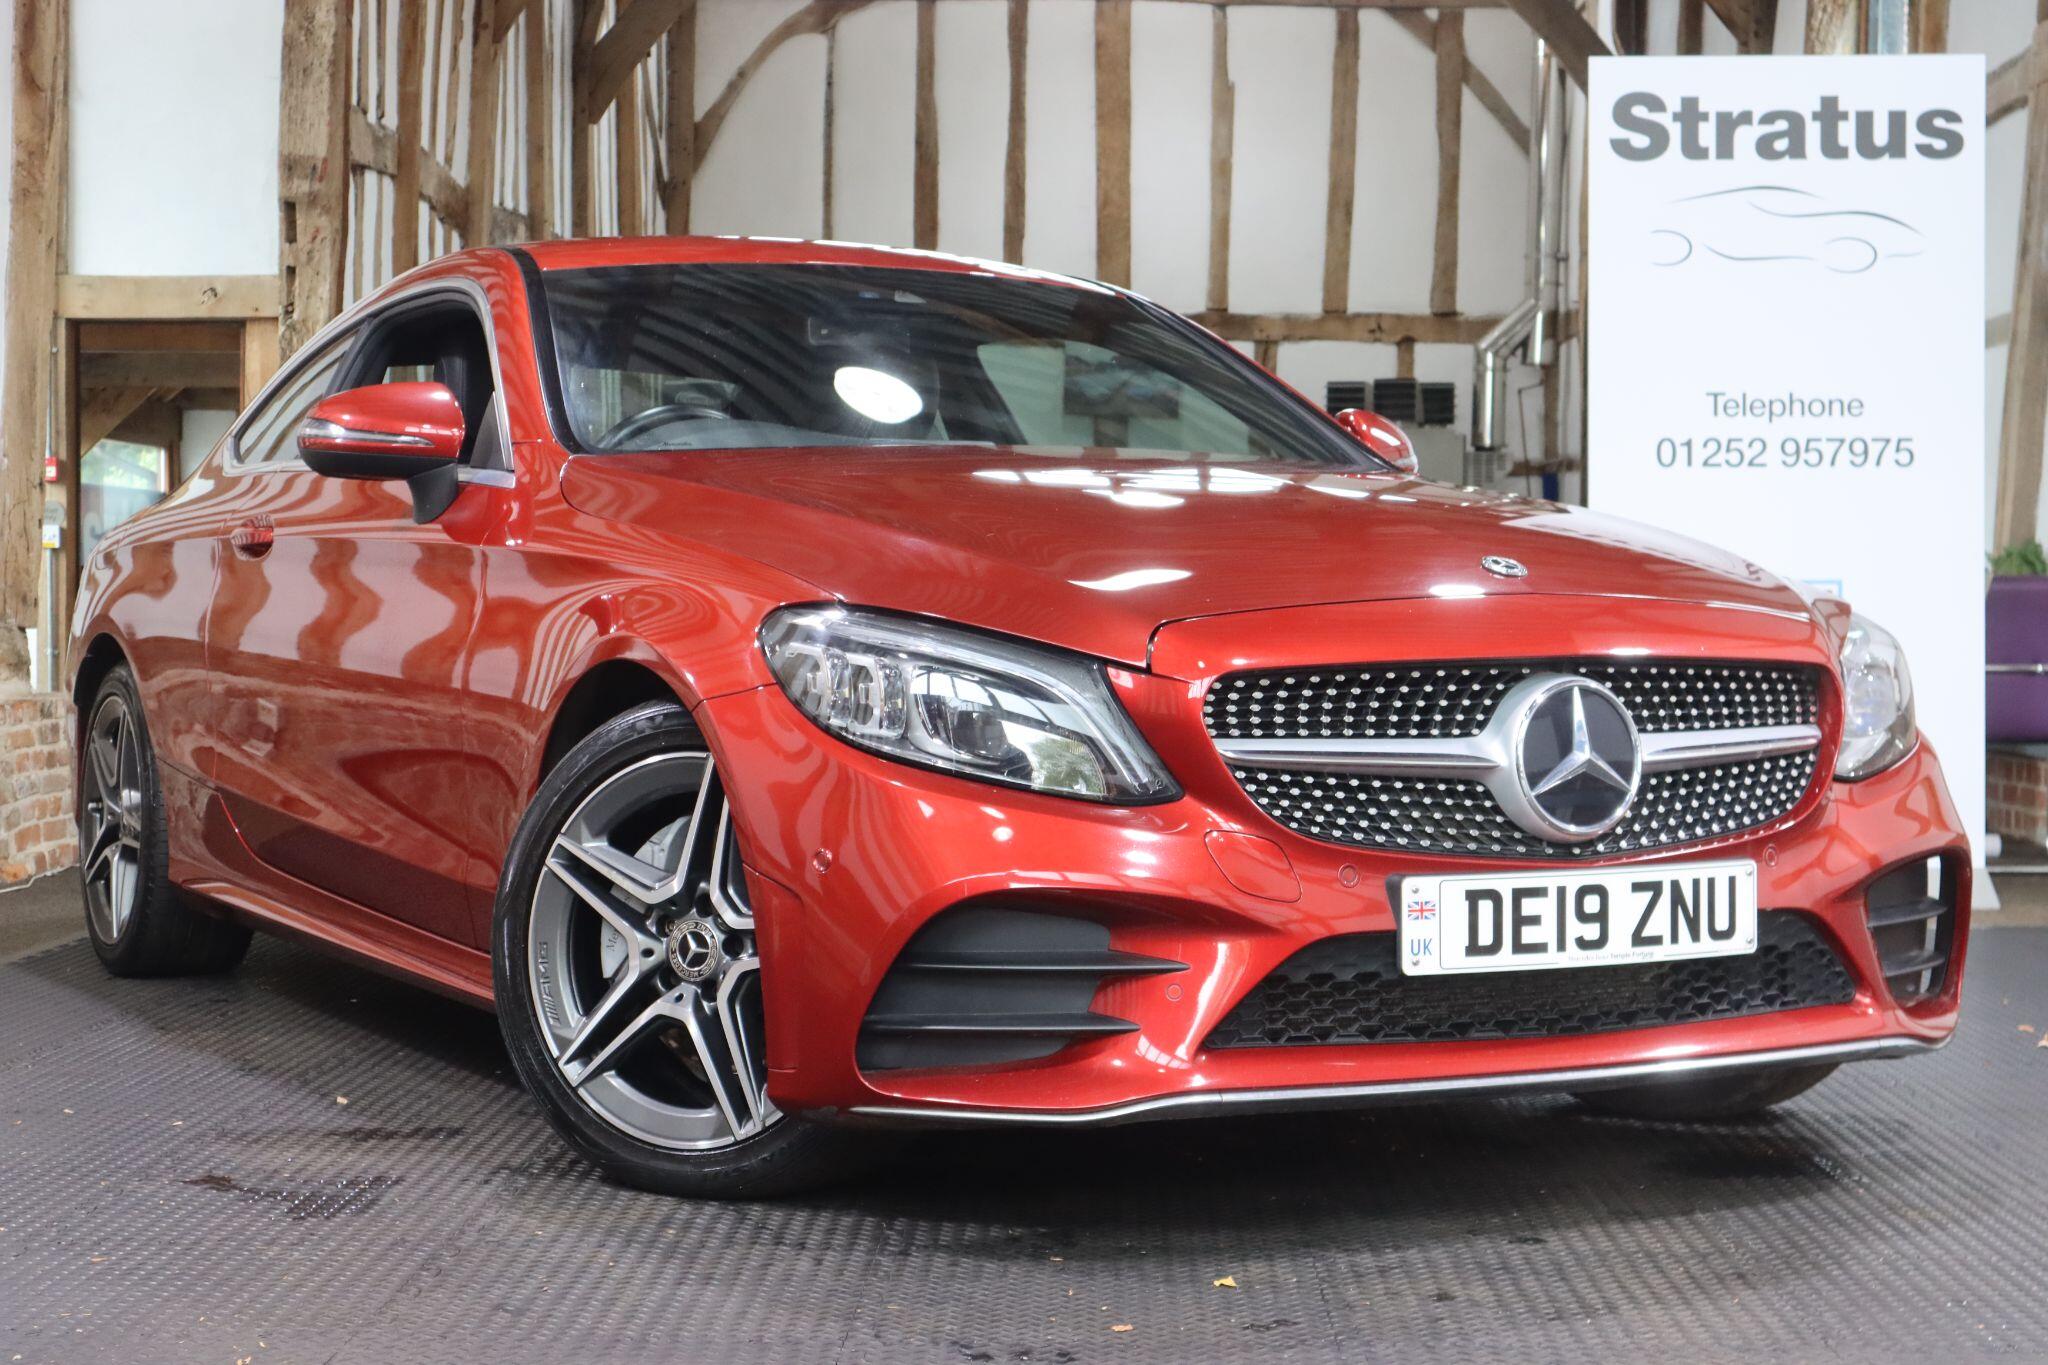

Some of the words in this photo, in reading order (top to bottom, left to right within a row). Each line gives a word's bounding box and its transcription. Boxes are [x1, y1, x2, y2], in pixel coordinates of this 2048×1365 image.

[1609, 91, 1965, 162] Stratus
[1705, 391, 1865, 423] Telephone
[1656, 437, 1768, 468] 01252
[1780, 437, 1915, 468] 957975
[1465, 884, 1609, 957] DE19
[1631, 875, 1737, 948] ZNU
[1410, 938, 1433, 957] UK
